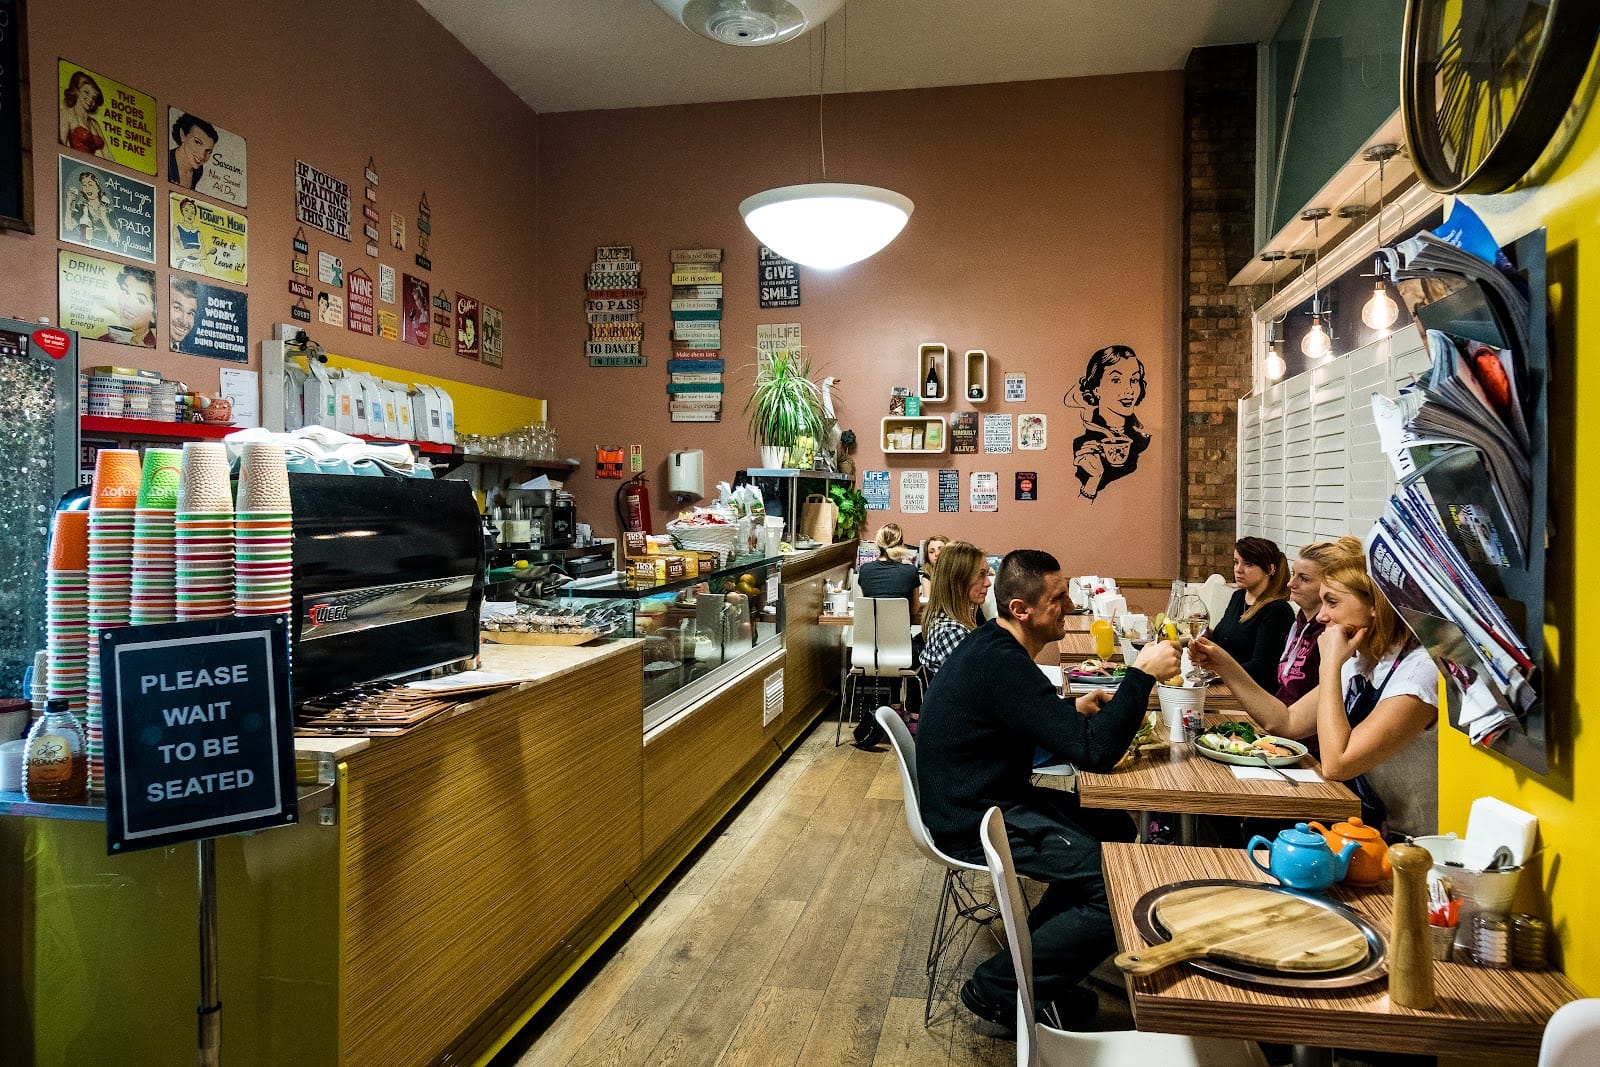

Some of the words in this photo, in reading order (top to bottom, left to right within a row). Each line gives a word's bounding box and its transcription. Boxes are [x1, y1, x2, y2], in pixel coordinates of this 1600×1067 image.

[117, 90, 135, 105] THE
[112, 99, 144, 119] BOOBS
[104, 108, 123, 123] ARE
[126, 116, 151, 135] REAL,
[103, 121, 121, 136] THE
[125, 130, 152, 147] SMILE
[110, 136, 119, 147] IS
[123, 141, 145, 156] FAKE
[298, 162, 309, 177] IF
[311, 168, 348, 197] YOU'RE
[105, 178, 120, 190] At
[120, 187, 132, 202] my
[135, 192, 151, 205] age,
[213, 182, 223, 192] All
[225, 186, 236, 200] Day
[300, 176, 347, 210] WAITING
[113, 196, 120, 208] I
[123, 204, 143, 215] need
[299, 191, 316, 212] FOR
[319, 201, 326, 215] A
[301, 206, 323, 228] THIS
[326, 217, 334, 232] IS
[118, 218, 150, 238] PAIR
[122, 236, 151, 253] glasses!
[212, 236, 228, 249] Take
[229, 242, 236, 251] it
[599, 248, 630, 260] LIFE
[69, 259, 105, 275] DRINK
[214, 256, 233, 270] Leave
[234, 264, 245, 273] it!
[616, 263, 637, 271] ABOUT
[765, 265, 794, 280] GIVE
[65, 272, 110, 288] COFFEE
[350, 275, 372, 298] WINE
[761, 286, 798, 300] SMILE
[208, 297, 233, 310] DON'T
[588, 301, 602, 310] TO
[607, 300, 640, 310] PASS
[205, 307, 237, 323] WORRY,
[610, 314, 634, 322] ABOUT
[71, 319, 96, 329] Energy
[202, 319, 214, 328] OUR
[215, 322, 232, 331] STAFF
[233, 325, 239, 333] IS
[197, 328, 235, 341] ACCUSTOMED
[236, 335, 243, 343] TO
[778, 327, 800, 338] LIFE
[195, 337, 213, 347] DUMB
[214, 341, 245, 353] QUESTIONS
[589, 344, 601, 354] TO
[605, 344, 636, 354] DANCE
[760, 340, 786, 349] GIVES
[865, 472, 883, 480] LIFE
[626, 532, 644, 540] TREK
[635, 562, 654, 570] TREK
[140, 664, 248, 694] PLEASE
[162, 701, 231, 727] WAIT
[158, 742, 196, 764] TO
[203, 735, 239, 758] BE
[146, 768, 255, 802] SEATED
